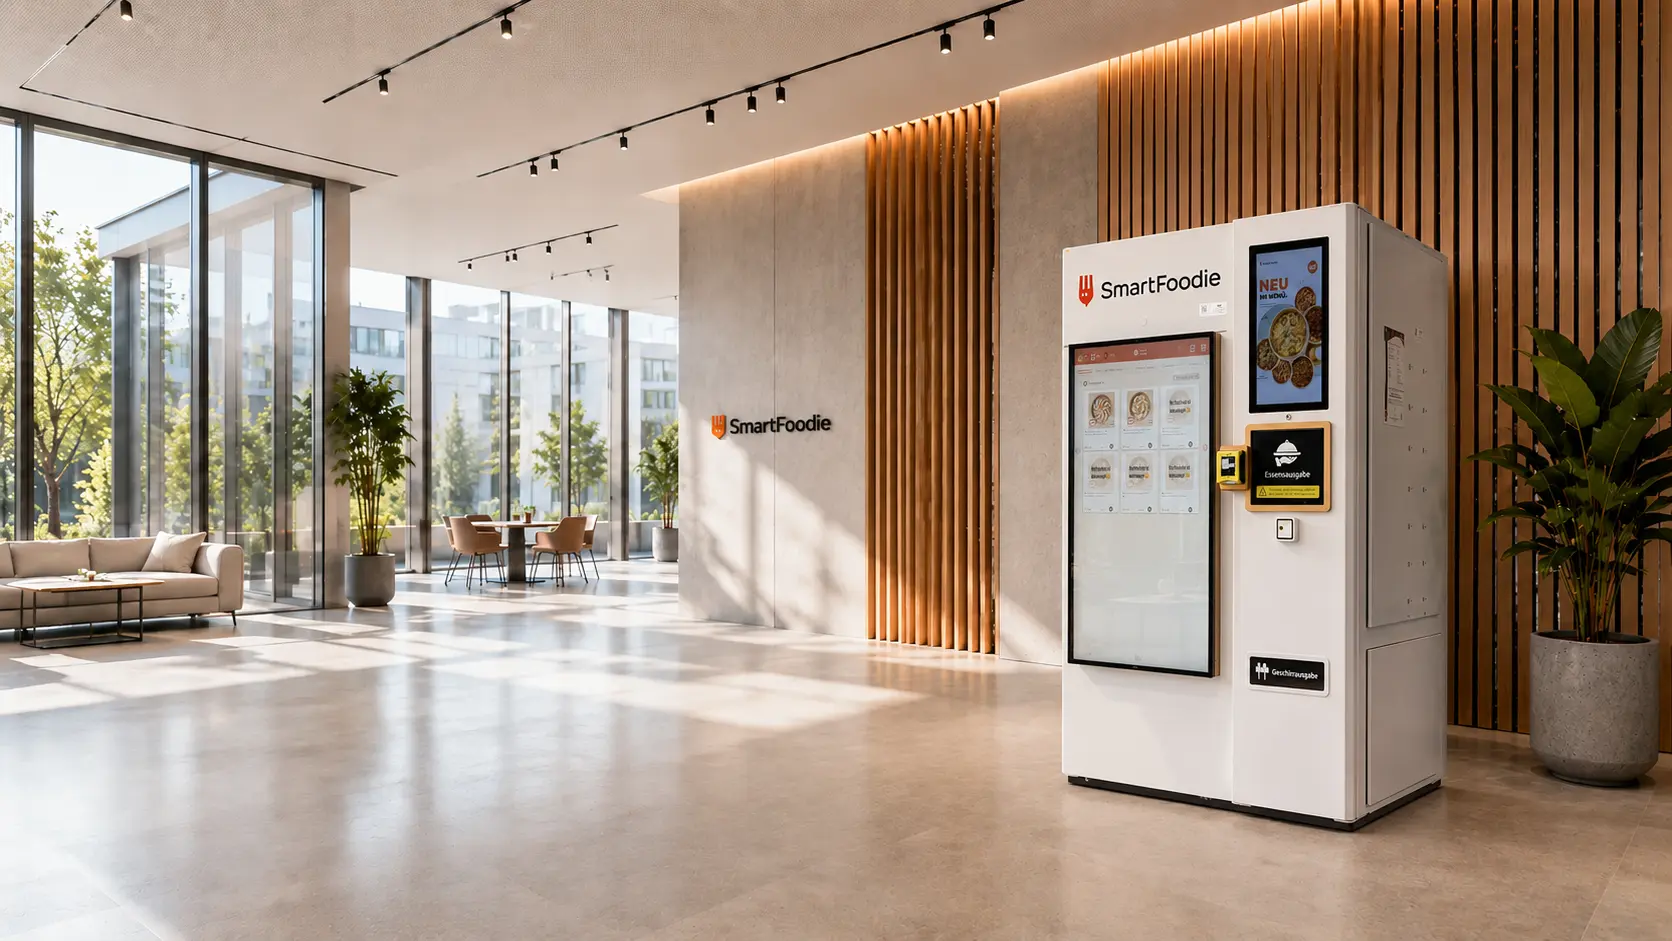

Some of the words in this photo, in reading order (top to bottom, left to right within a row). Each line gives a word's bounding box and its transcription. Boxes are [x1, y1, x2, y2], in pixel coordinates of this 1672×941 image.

[1101, 269, 1221, 299] SmartFoodie
[1259, 277, 1289, 292] NEU
[730, 414, 832, 434] SmartFoodie
[1264, 470, 1311, 480] Essensausgabe
